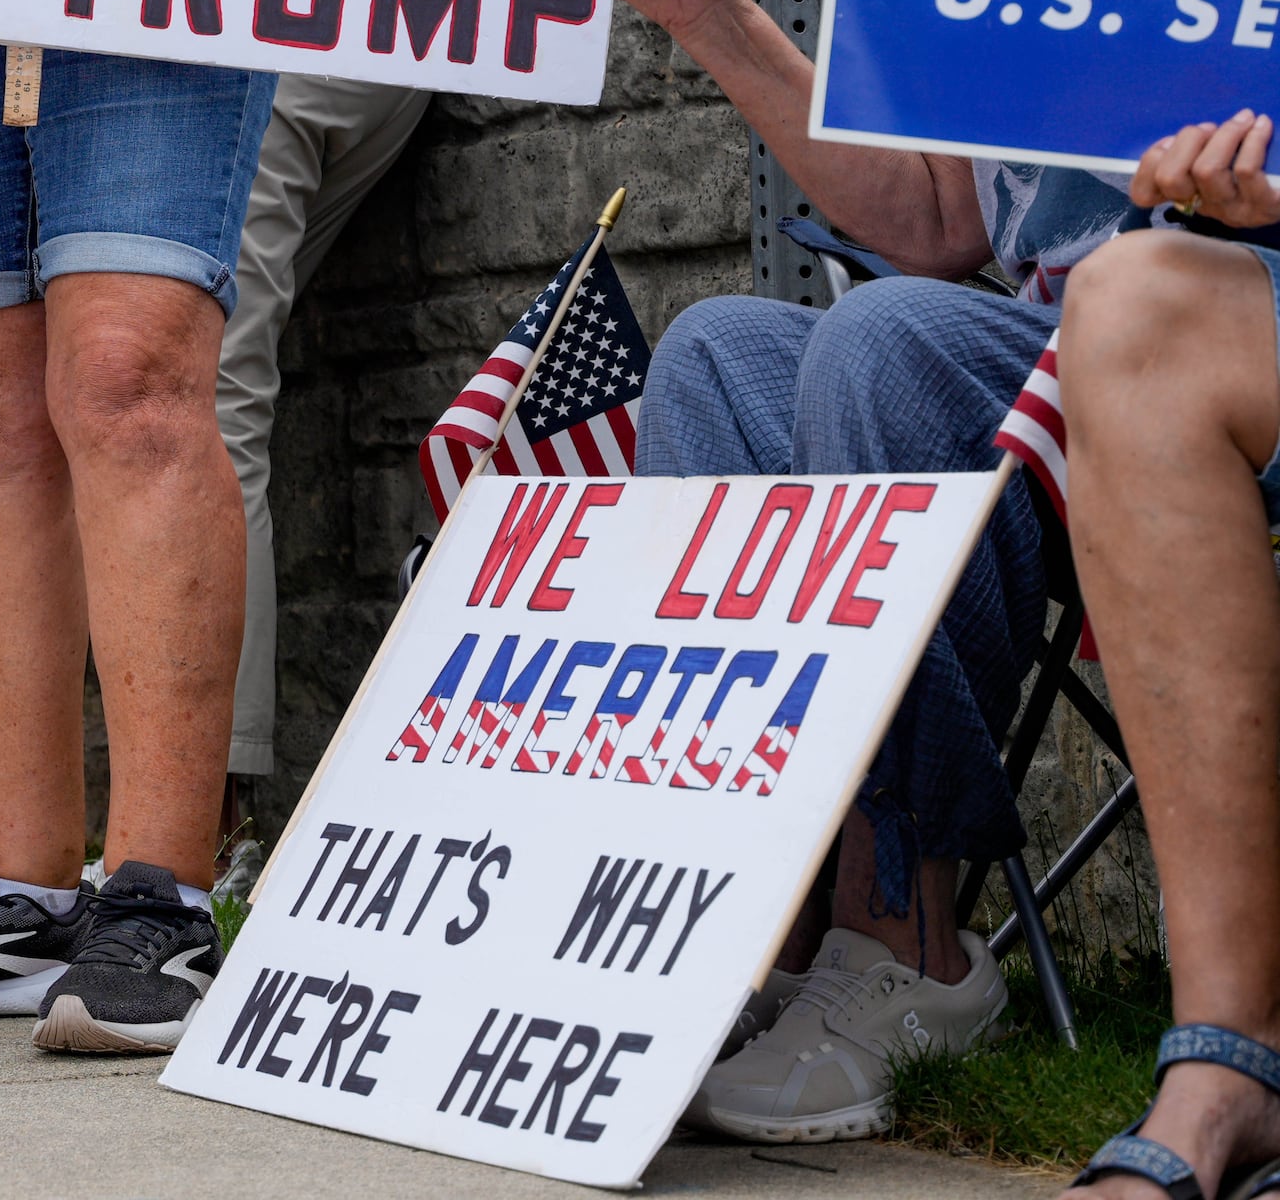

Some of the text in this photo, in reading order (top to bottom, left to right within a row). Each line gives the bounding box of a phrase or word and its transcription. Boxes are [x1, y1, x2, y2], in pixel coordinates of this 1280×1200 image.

[465, 482, 937, 629] WE LOVE
[386, 632, 829, 798] AMERICA
[289, 823, 735, 978] THAT'S WHY
[216, 966, 653, 1144] WE'RE HERE
